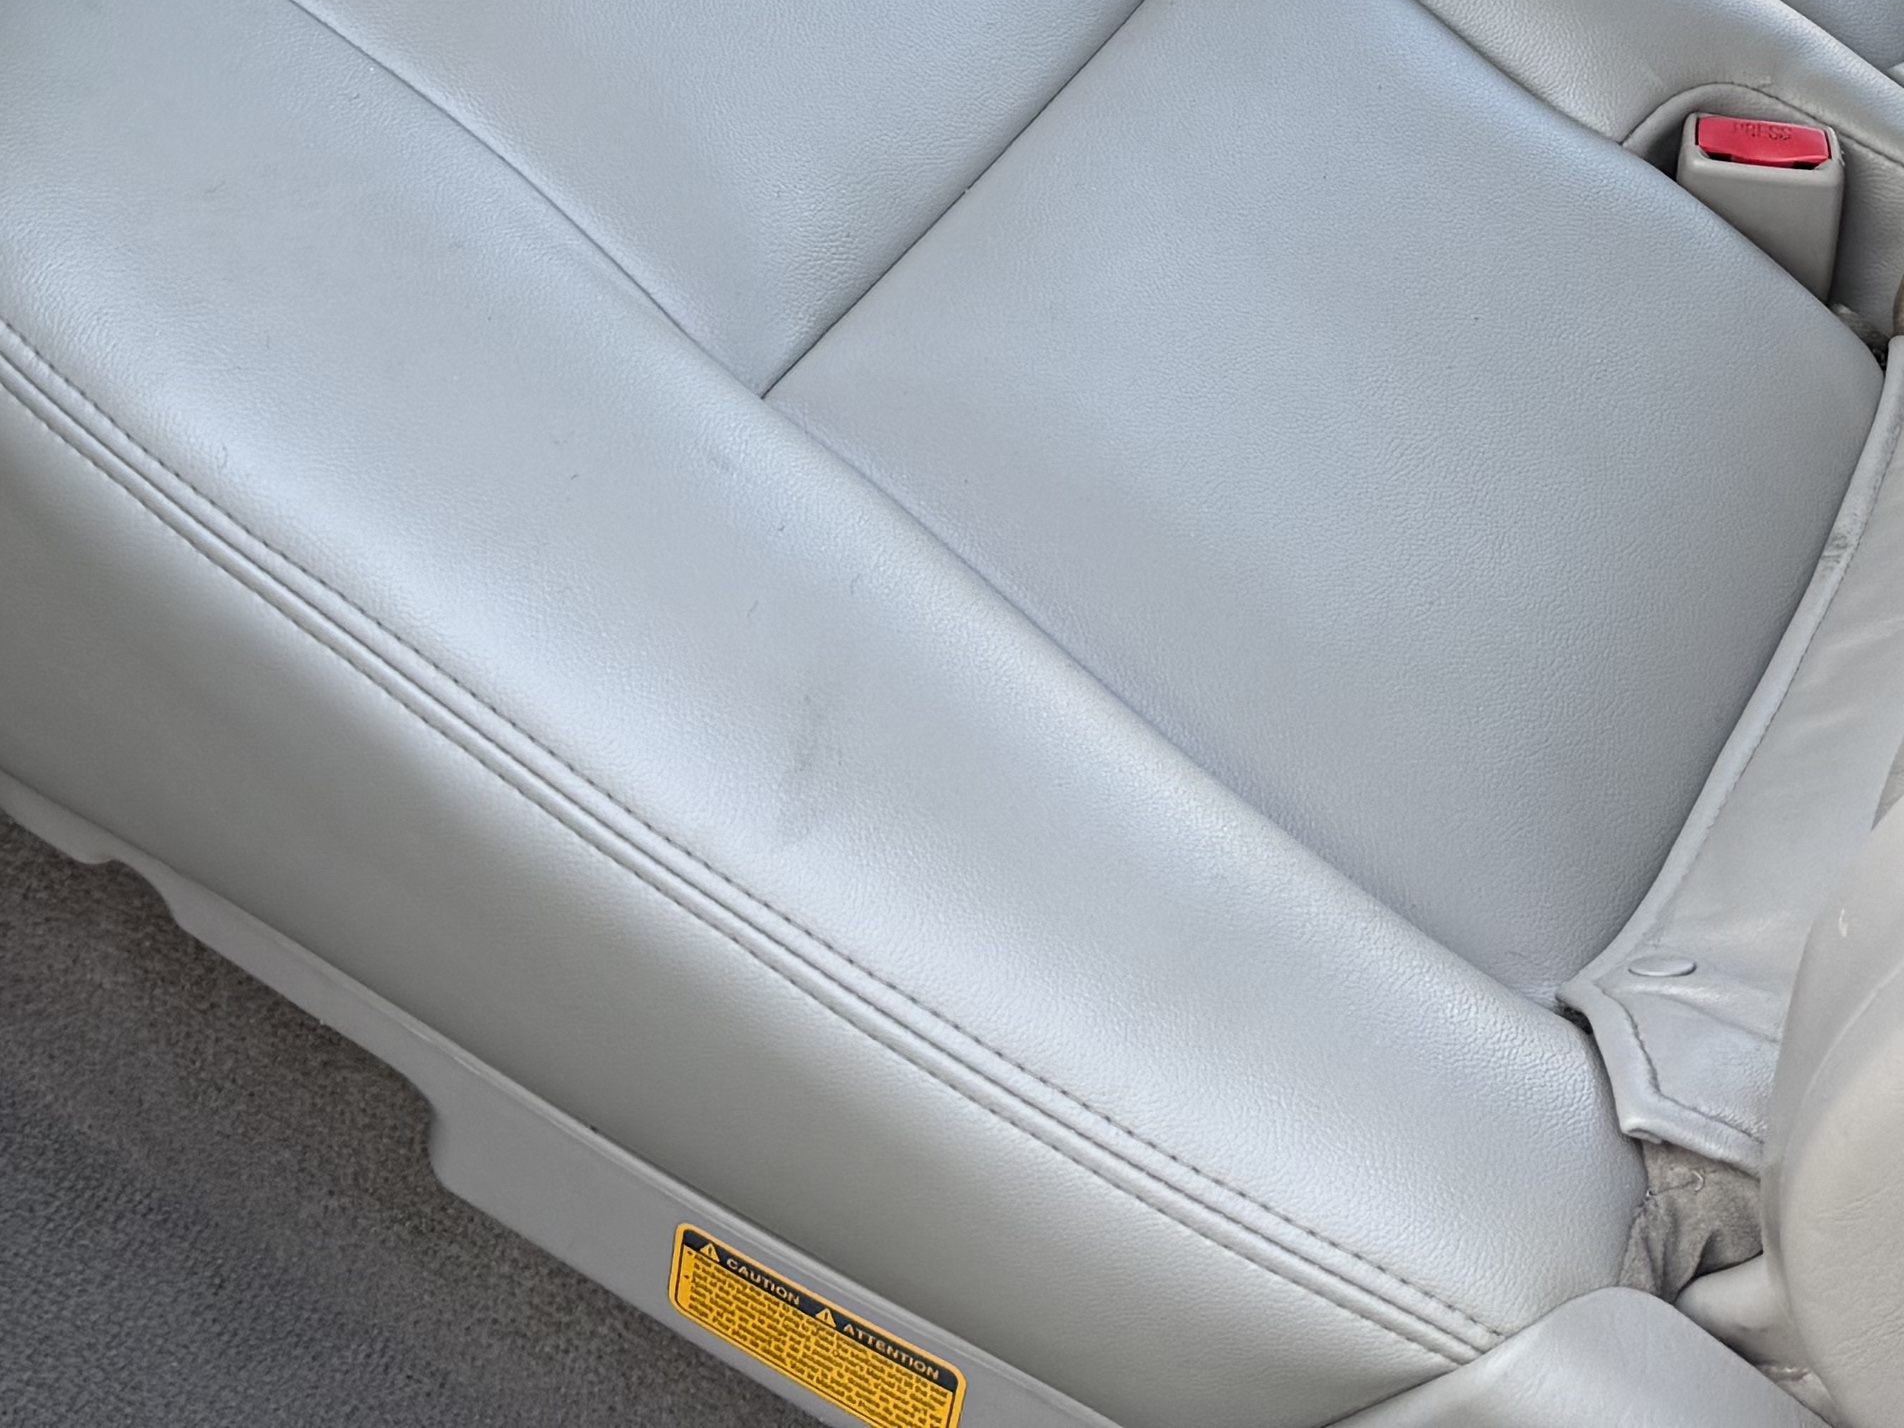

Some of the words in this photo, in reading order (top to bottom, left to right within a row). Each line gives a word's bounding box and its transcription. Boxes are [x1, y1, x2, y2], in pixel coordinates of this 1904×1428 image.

[1732, 122, 1793, 141] PRESS
[726, 1258, 800, 1306] CAUTION
[843, 1323, 939, 1380] ATTENTION
